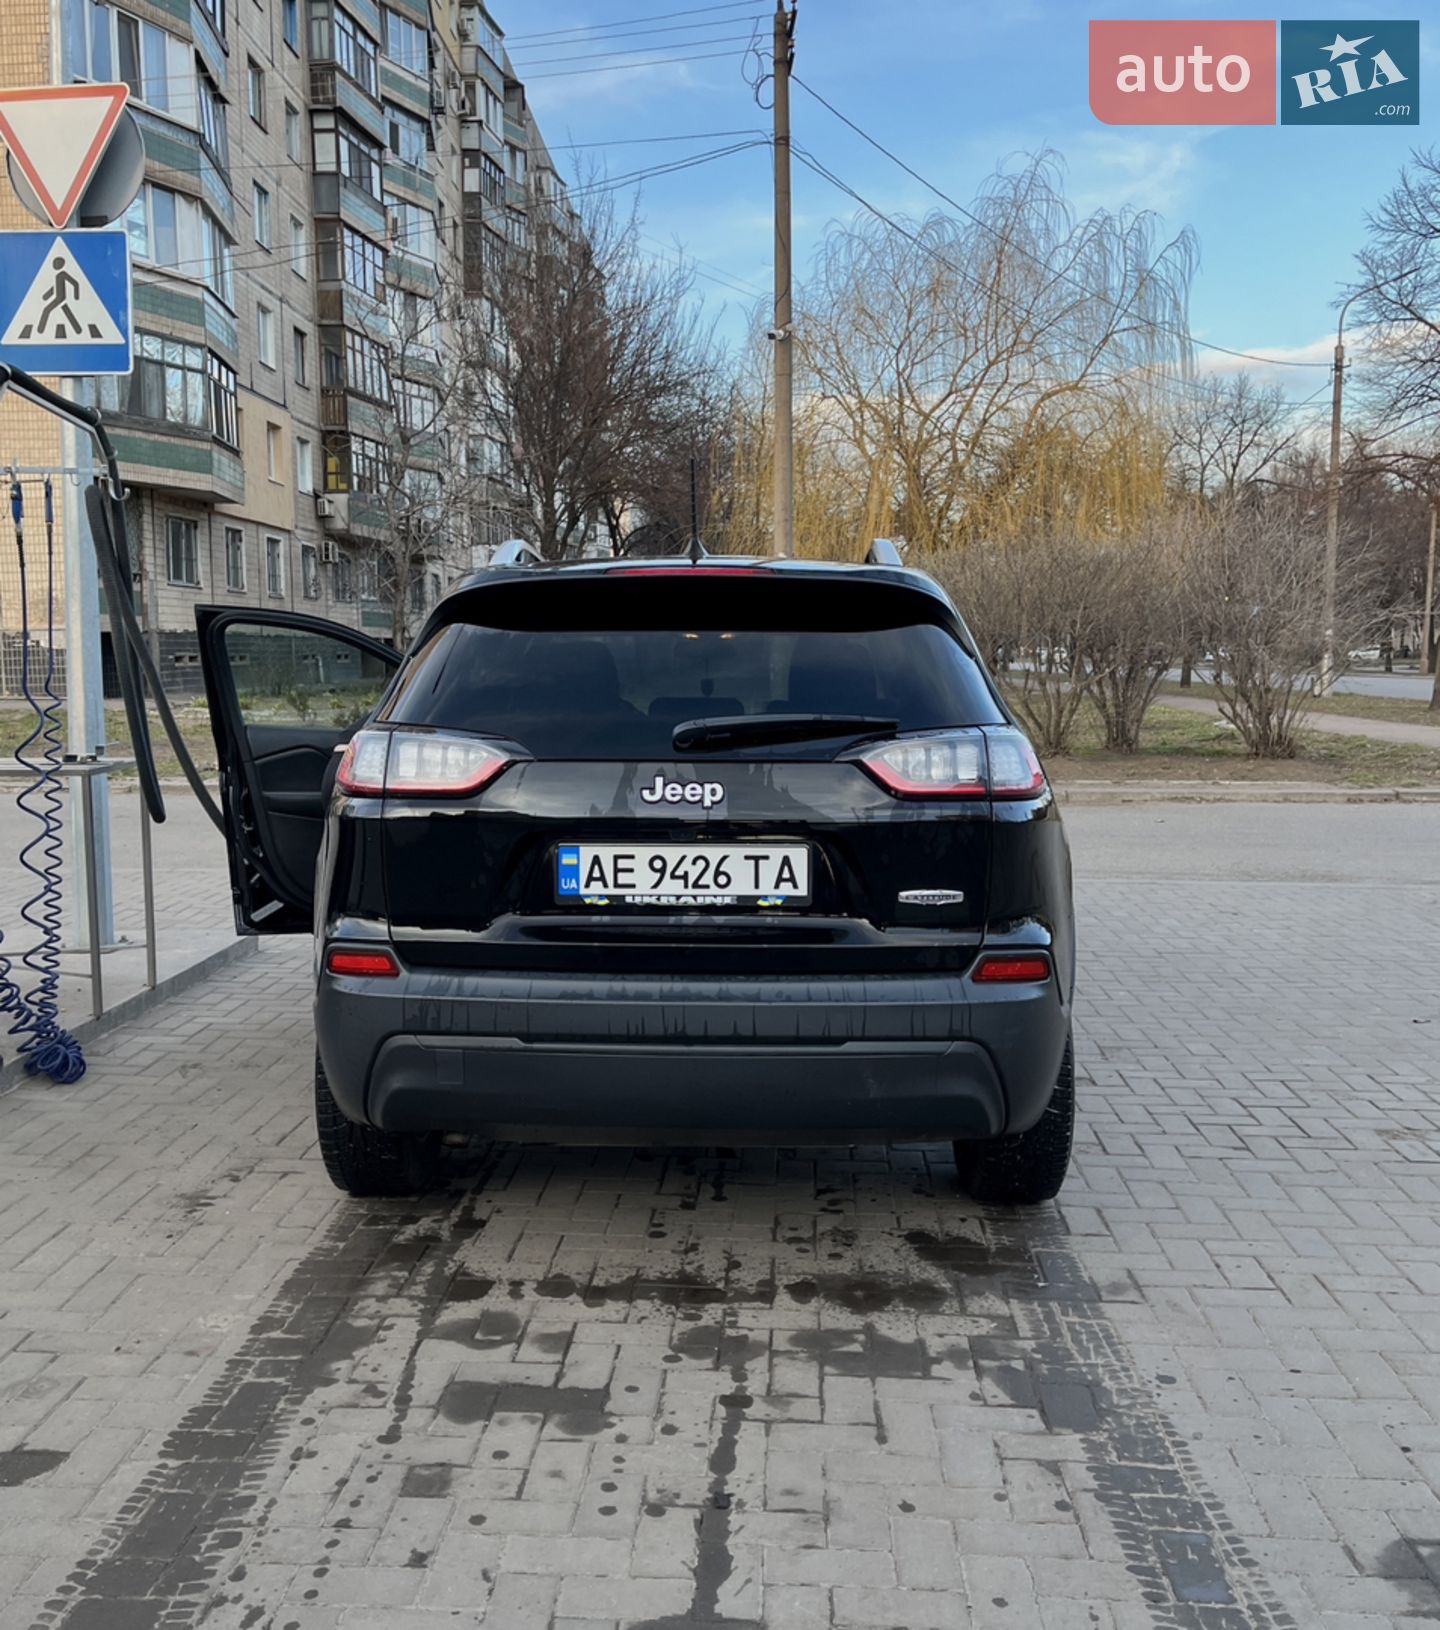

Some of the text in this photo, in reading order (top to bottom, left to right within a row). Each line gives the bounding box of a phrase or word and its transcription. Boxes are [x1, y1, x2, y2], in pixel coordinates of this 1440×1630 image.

[641, 775, 725, 808] Jeep
[561, 878, 578, 889] UA
[583, 854, 799, 890] AE 9426 TA
